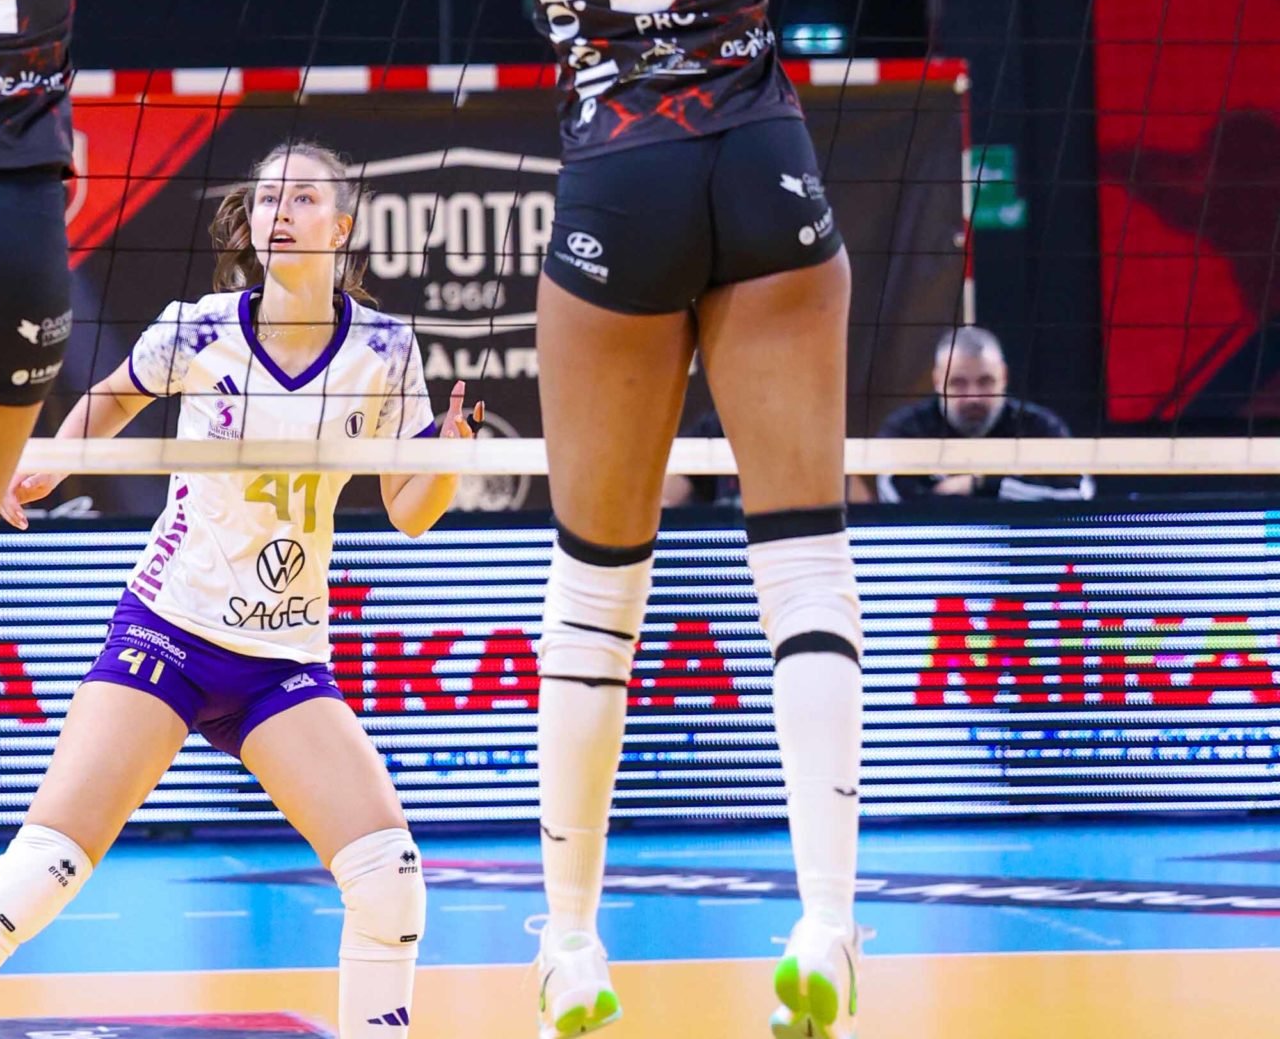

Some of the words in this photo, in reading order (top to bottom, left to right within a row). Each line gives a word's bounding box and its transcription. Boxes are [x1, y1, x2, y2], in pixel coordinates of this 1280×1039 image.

[245, 474, 322, 534] 41
[222, 596, 322, 630] SAGEC
[117, 647, 166, 685] 41
